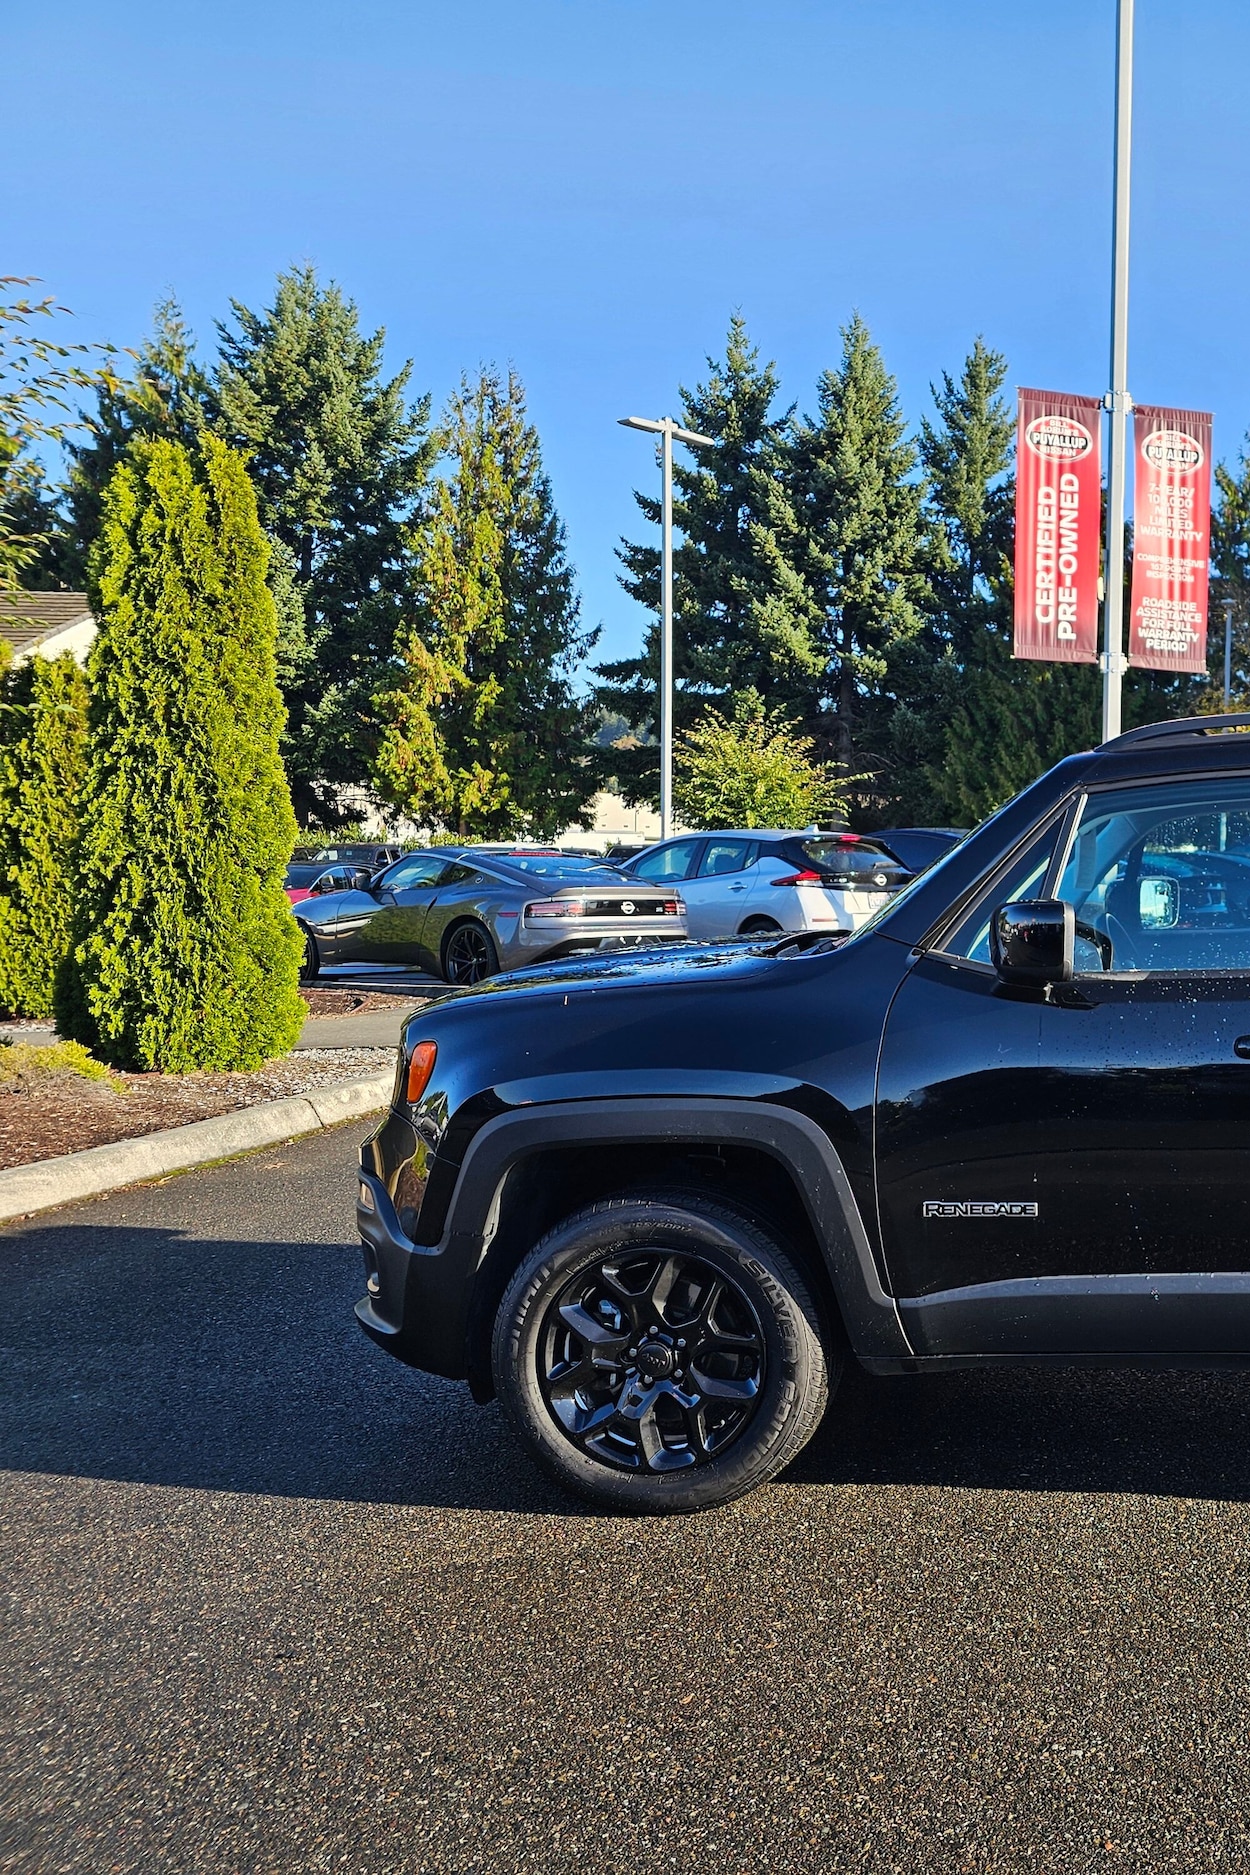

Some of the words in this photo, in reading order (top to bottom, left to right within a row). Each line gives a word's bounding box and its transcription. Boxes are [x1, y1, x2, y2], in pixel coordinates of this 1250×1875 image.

[1033, 432, 1087, 449] PUYALLUP
[1039, 445, 1076, 457] NISSAN
[1155, 506, 1188, 519] MILES
[1150, 515, 1193, 530] LIMITED
[1140, 525, 1203, 542] WARRANTY
[1035, 486, 1056, 624] CERTIFIED
[1057, 473, 1080, 641] PRE-OWNED
[1142, 596, 1197, 611] ROADSIDE
[1136, 607, 1202, 622] ASSISTANCE
[1142, 616, 1165, 629] FOR
[1166, 620, 1193, 632] FULL
[1138, 627, 1199, 643] WARRANTY
[1146, 638, 1188, 652] PERIOD
[923, 1201, 1038, 1217] RENEGADE
